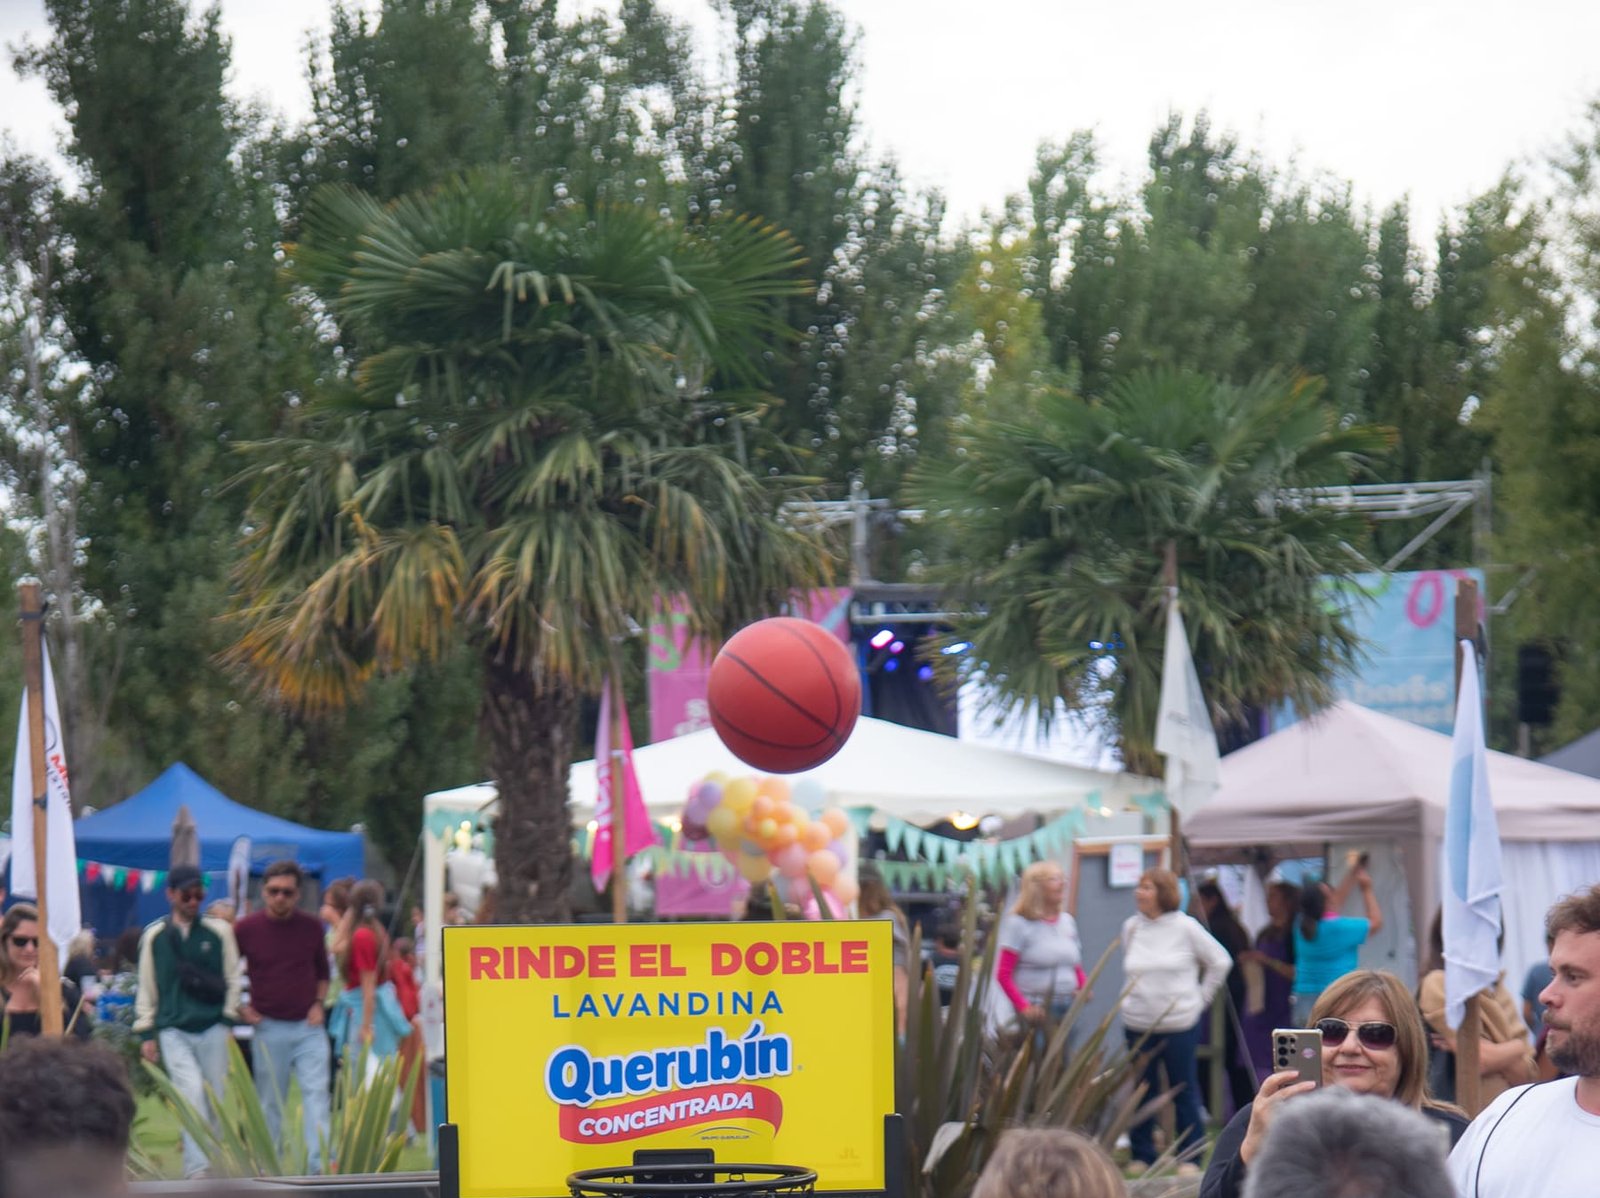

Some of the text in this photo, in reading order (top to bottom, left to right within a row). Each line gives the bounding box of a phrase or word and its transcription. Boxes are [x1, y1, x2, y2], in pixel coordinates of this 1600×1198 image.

[470, 941, 869, 980] RINDE EL DOBLE
[553, 991, 783, 1018] LAVANDINA
[548, 1023, 790, 1104] Querubín
[578, 1092, 755, 1136] CONCENTRADA
